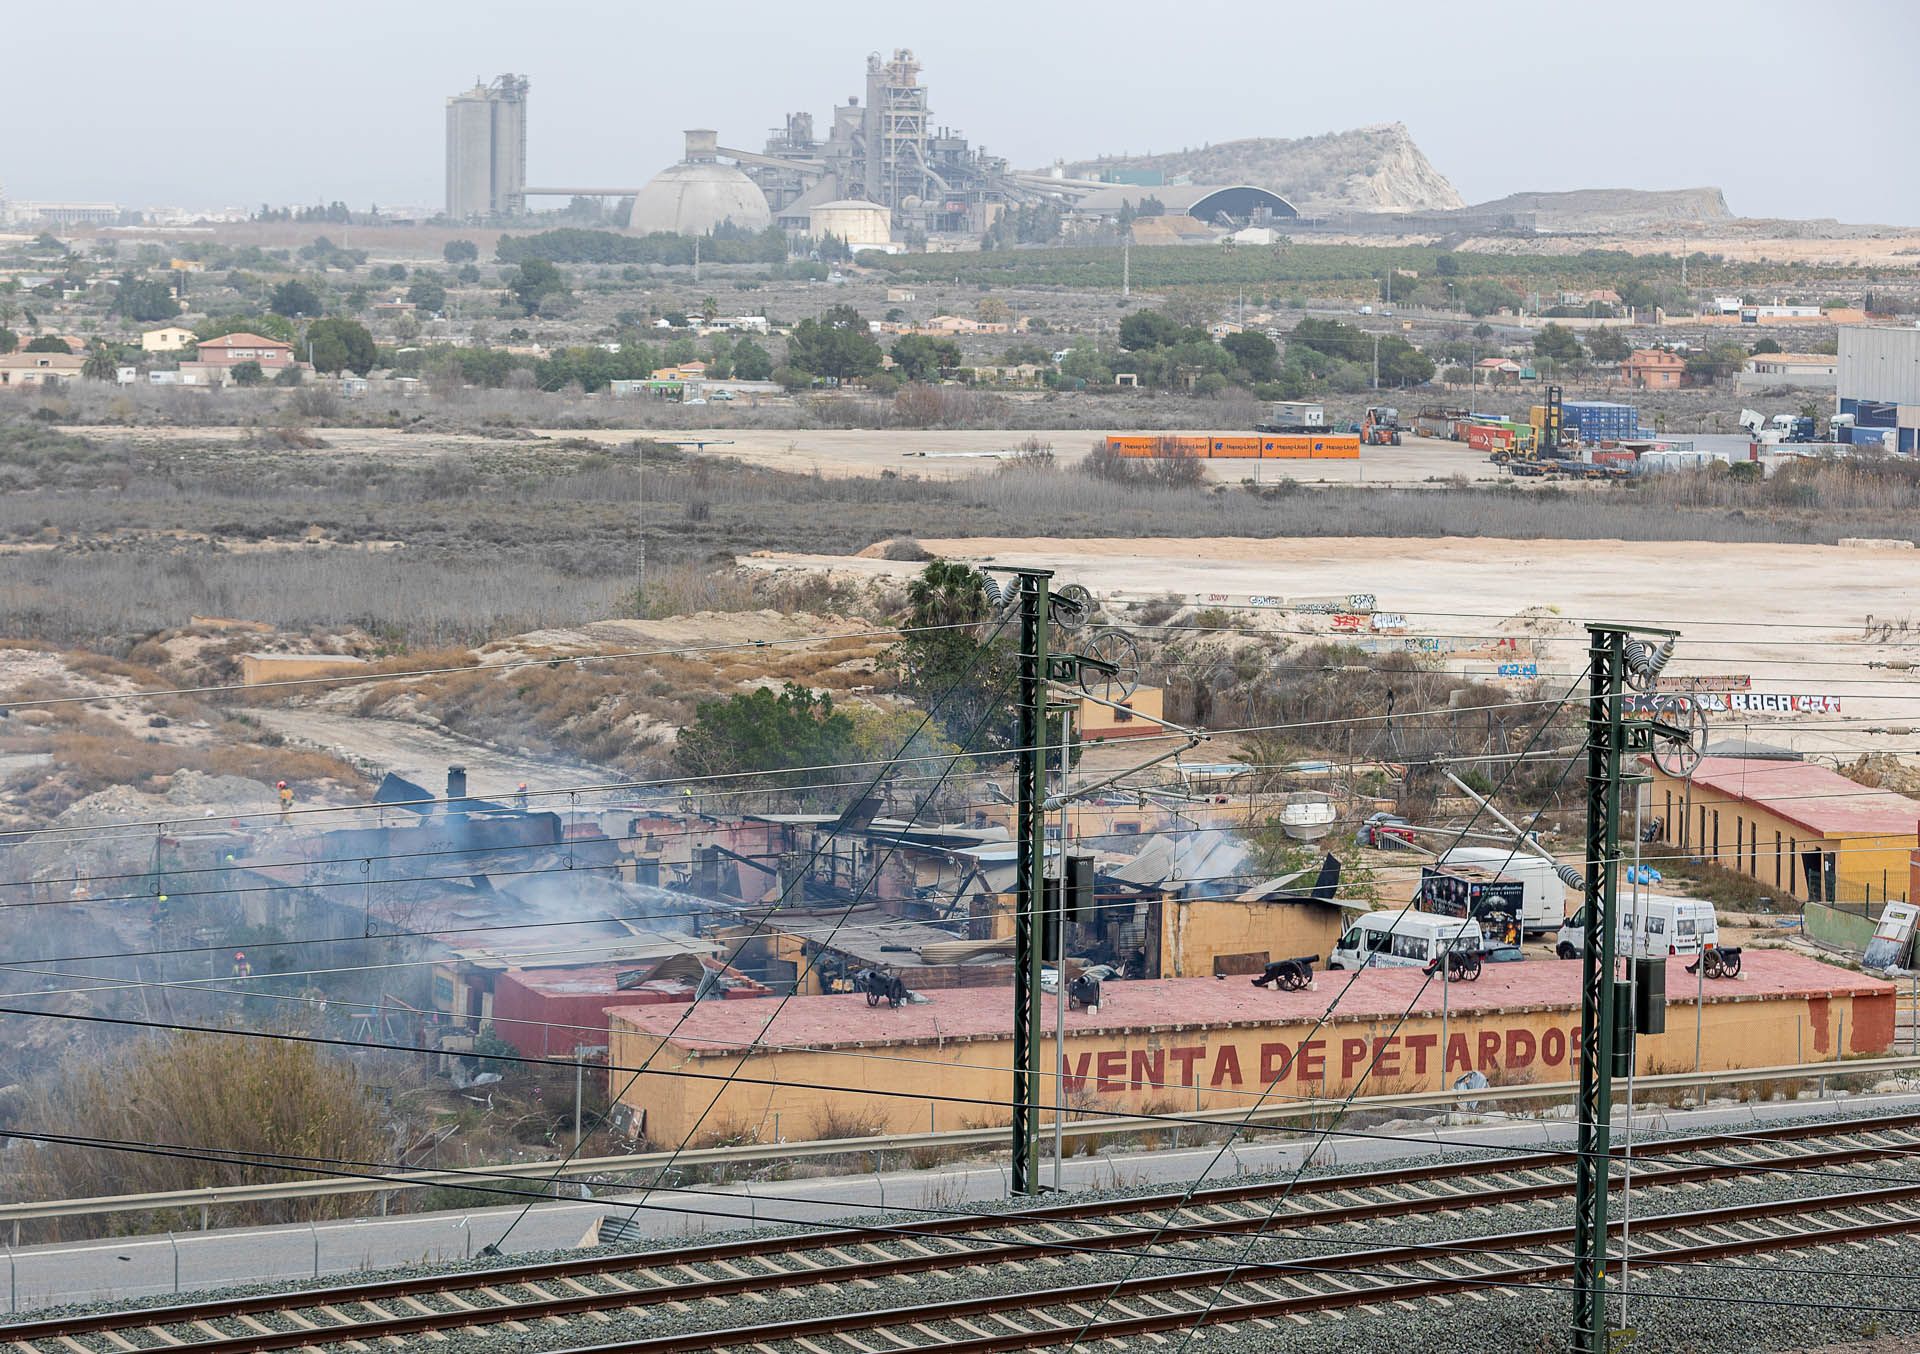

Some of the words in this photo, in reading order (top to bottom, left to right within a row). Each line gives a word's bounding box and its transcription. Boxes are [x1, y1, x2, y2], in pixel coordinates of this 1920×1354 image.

[1062, 1044, 1243, 1094] VENTA
[1259, 1040, 1326, 1083] DE
[1341, 1027, 1582, 1078] PETARDOS
